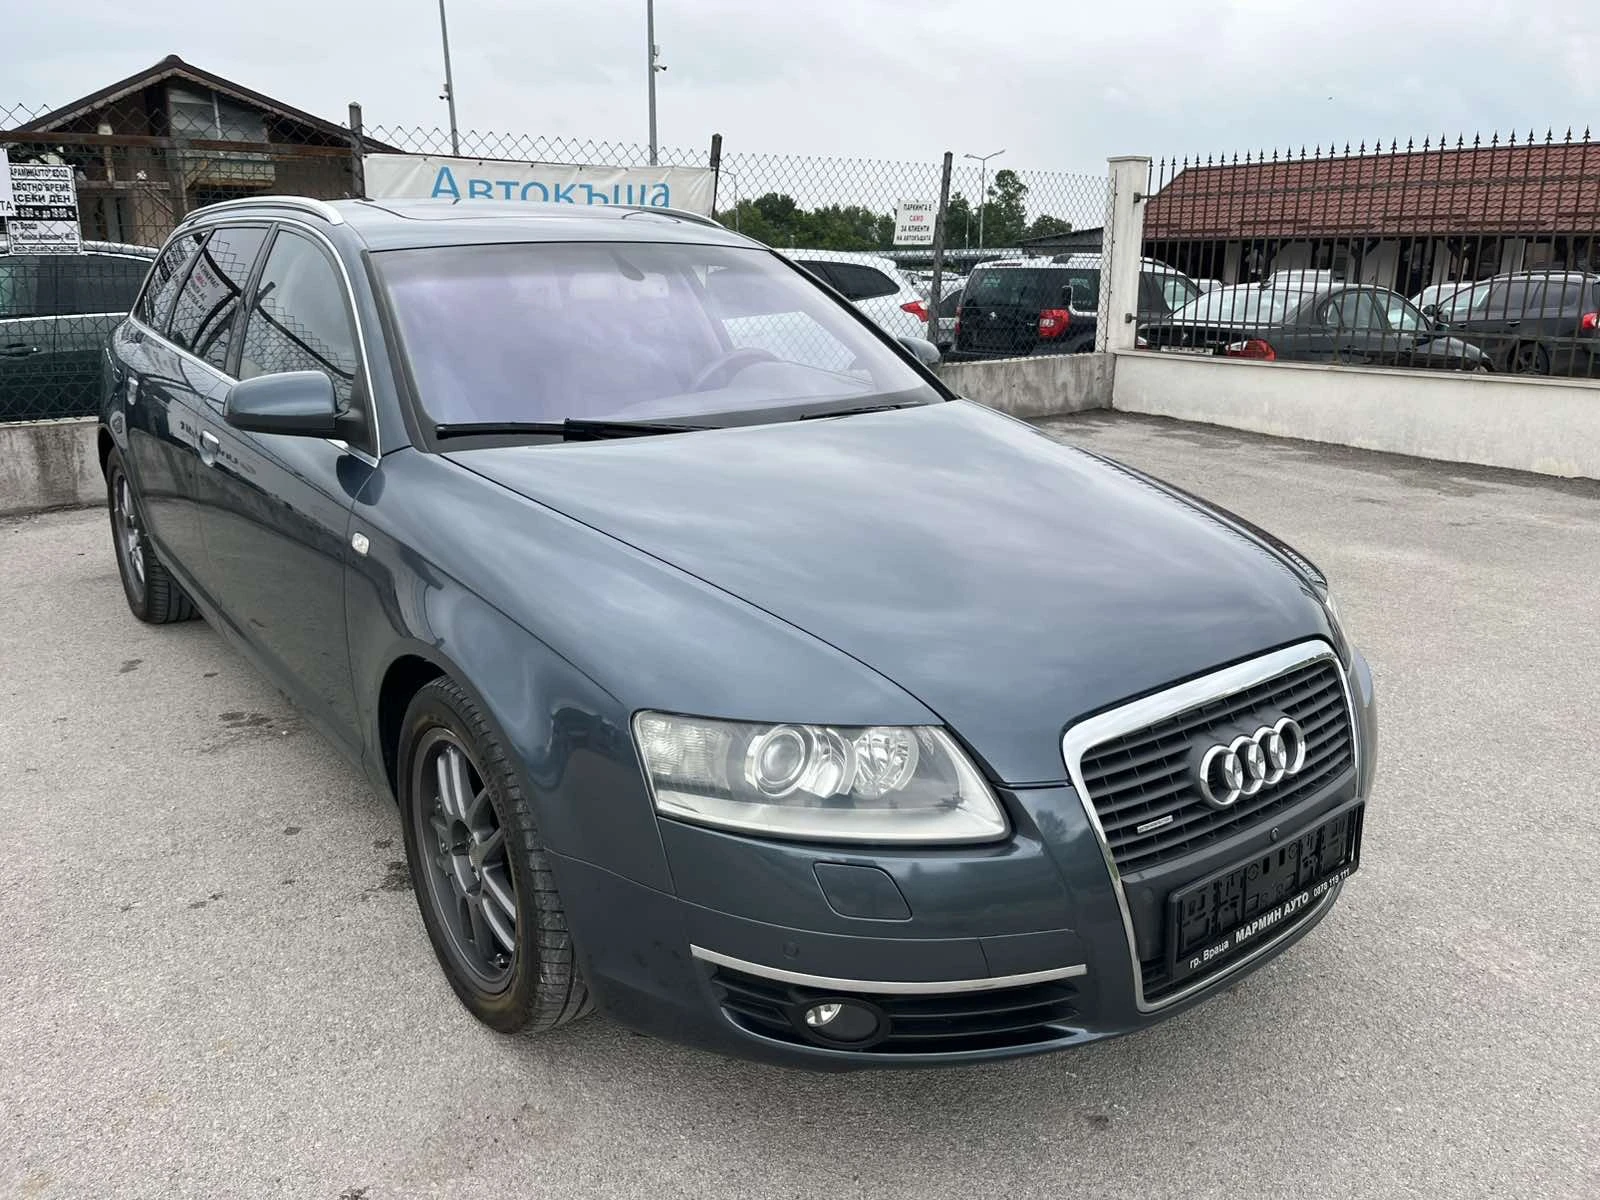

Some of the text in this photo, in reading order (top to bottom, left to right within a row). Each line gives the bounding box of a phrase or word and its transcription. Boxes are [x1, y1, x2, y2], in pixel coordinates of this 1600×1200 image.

[13, 193, 71, 204] СЕКИ ДЕН
[1189, 957, 1201, 969] гр.
[1203, 940, 1229, 961] Враца
[1235, 907, 1282, 944] МАРМИН
[1283, 891, 1309, 917] АУТО
